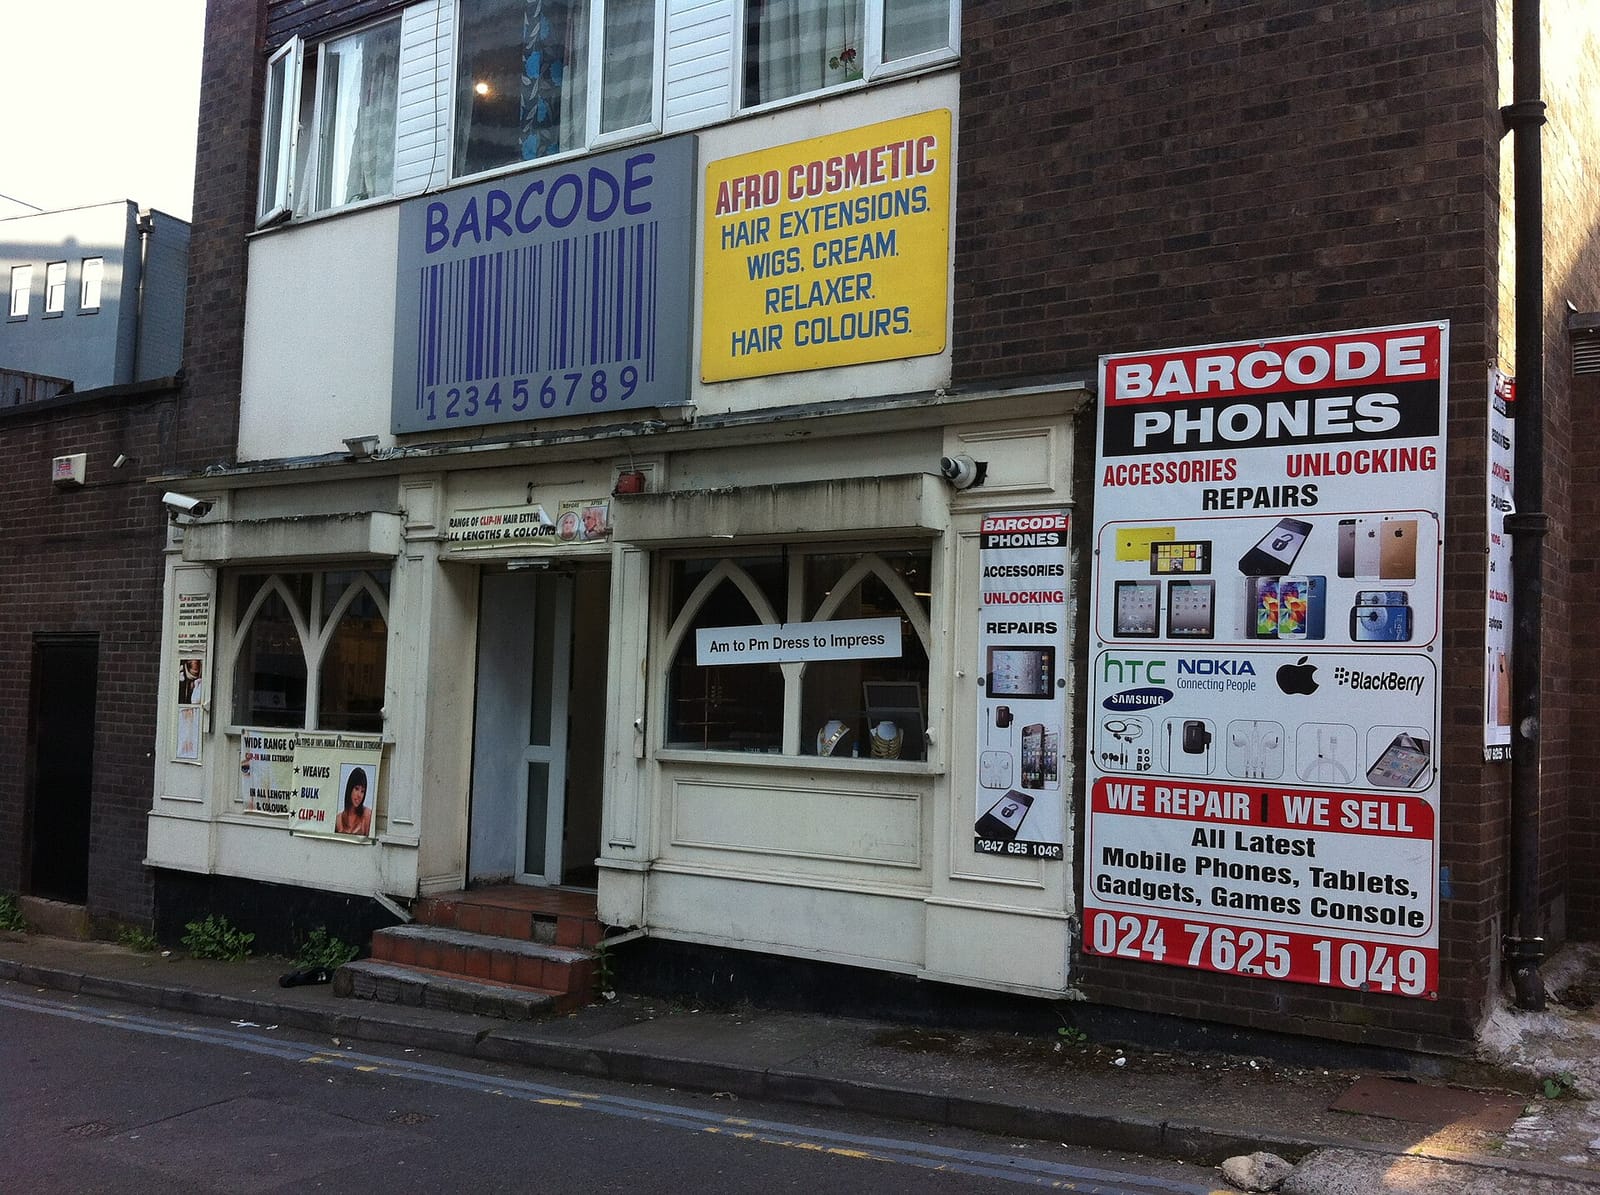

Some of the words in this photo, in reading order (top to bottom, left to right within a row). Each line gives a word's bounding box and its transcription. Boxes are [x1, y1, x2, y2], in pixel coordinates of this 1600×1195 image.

[715, 170, 781, 217] AFRO
[786, 135, 938, 201] COSMETIC
[425, 153, 656, 254] BARCODE
[721, 216, 771, 250] HAIR
[780, 185, 931, 234] EXTENSIONS.
[747, 250, 806, 281] WIGS.
[812, 230, 900, 270] CREAM.
[764, 273, 876, 315] RELAXER.
[731, 325, 783, 357] HAIR
[794, 306, 913, 347] COLOURS.
[1115, 335, 1427, 400] BARCODE
[427, 366, 639, 422] 123456789
[1133, 393, 1401, 448] PHONES
[1103, 458, 1238, 487] ACCESSORIES
[1286, 446, 1437, 478] UNLOCKING
[1202, 484, 1319, 511] REPAIRS
[449, 517, 470, 528] RANGE
[470, 516, 479, 527] OF
[480, 514, 502, 527] CLIP-IN
[503, 513, 518, 524] HAIR
[983, 516, 1066, 532] BARCODE
[462, 528, 501, 541] LENGTHS
[503, 529, 511, 538] &
[514, 524, 556, 538] COLOURS
[988, 532, 1060, 547] PHONES
[983, 564, 1065, 578] ACCESSORIES
[984, 591, 1064, 605] UNLOCKING
[986, 622, 1058, 634] REPAIRS
[709, 640, 730, 653] Am
[733, 639, 745, 651] to
[749, 638, 769, 651] Pm
[773, 636, 810, 650] Dress
[813, 635, 827, 648] to
[831, 633, 885, 649] Impress
[1177, 659, 1257, 676] NOKIA
[1350, 669, 1425, 696] BlackBerry
[1177, 677, 1225, 692] Connecting
[1226, 679, 1257, 693] People
[1111, 694, 1165, 706] SAMSUNG
[244, 737, 262, 749] WIDE
[263, 738, 287, 750] RANGE
[302, 765, 330, 779] WEAVES
[250, 787, 255, 797] IN
[256, 788, 266, 798] ALL
[267, 789, 291, 801] LENGTH
[300, 787, 319, 800] BULK
[262, 802, 288, 813] COLOURS
[298, 808, 325, 821] CLIP-IN
[1106, 783, 1146, 813] WE
[1154, 786, 1251, 821] REPAIR
[1282, 795, 1332, 826] WE
[1340, 800, 1414, 833] SELL
[1007, 842, 1028, 855] 625
[1191, 827, 1226, 850] All
[1234, 831, 1316, 858] Latest
[1102, 846, 1187, 875] Mobile
[1196, 855, 1300, 888] Phones,
[1309, 866, 1419, 900] Tablets,
[1096, 874, 1203, 907] Gadgets,
[1210, 887, 1302, 917] Games
[1310, 897, 1425, 929] Console
[1092, 912, 1168, 962] 024
[1184, 924, 1291, 978] 7625
[1312, 939, 1427, 996] 1049
